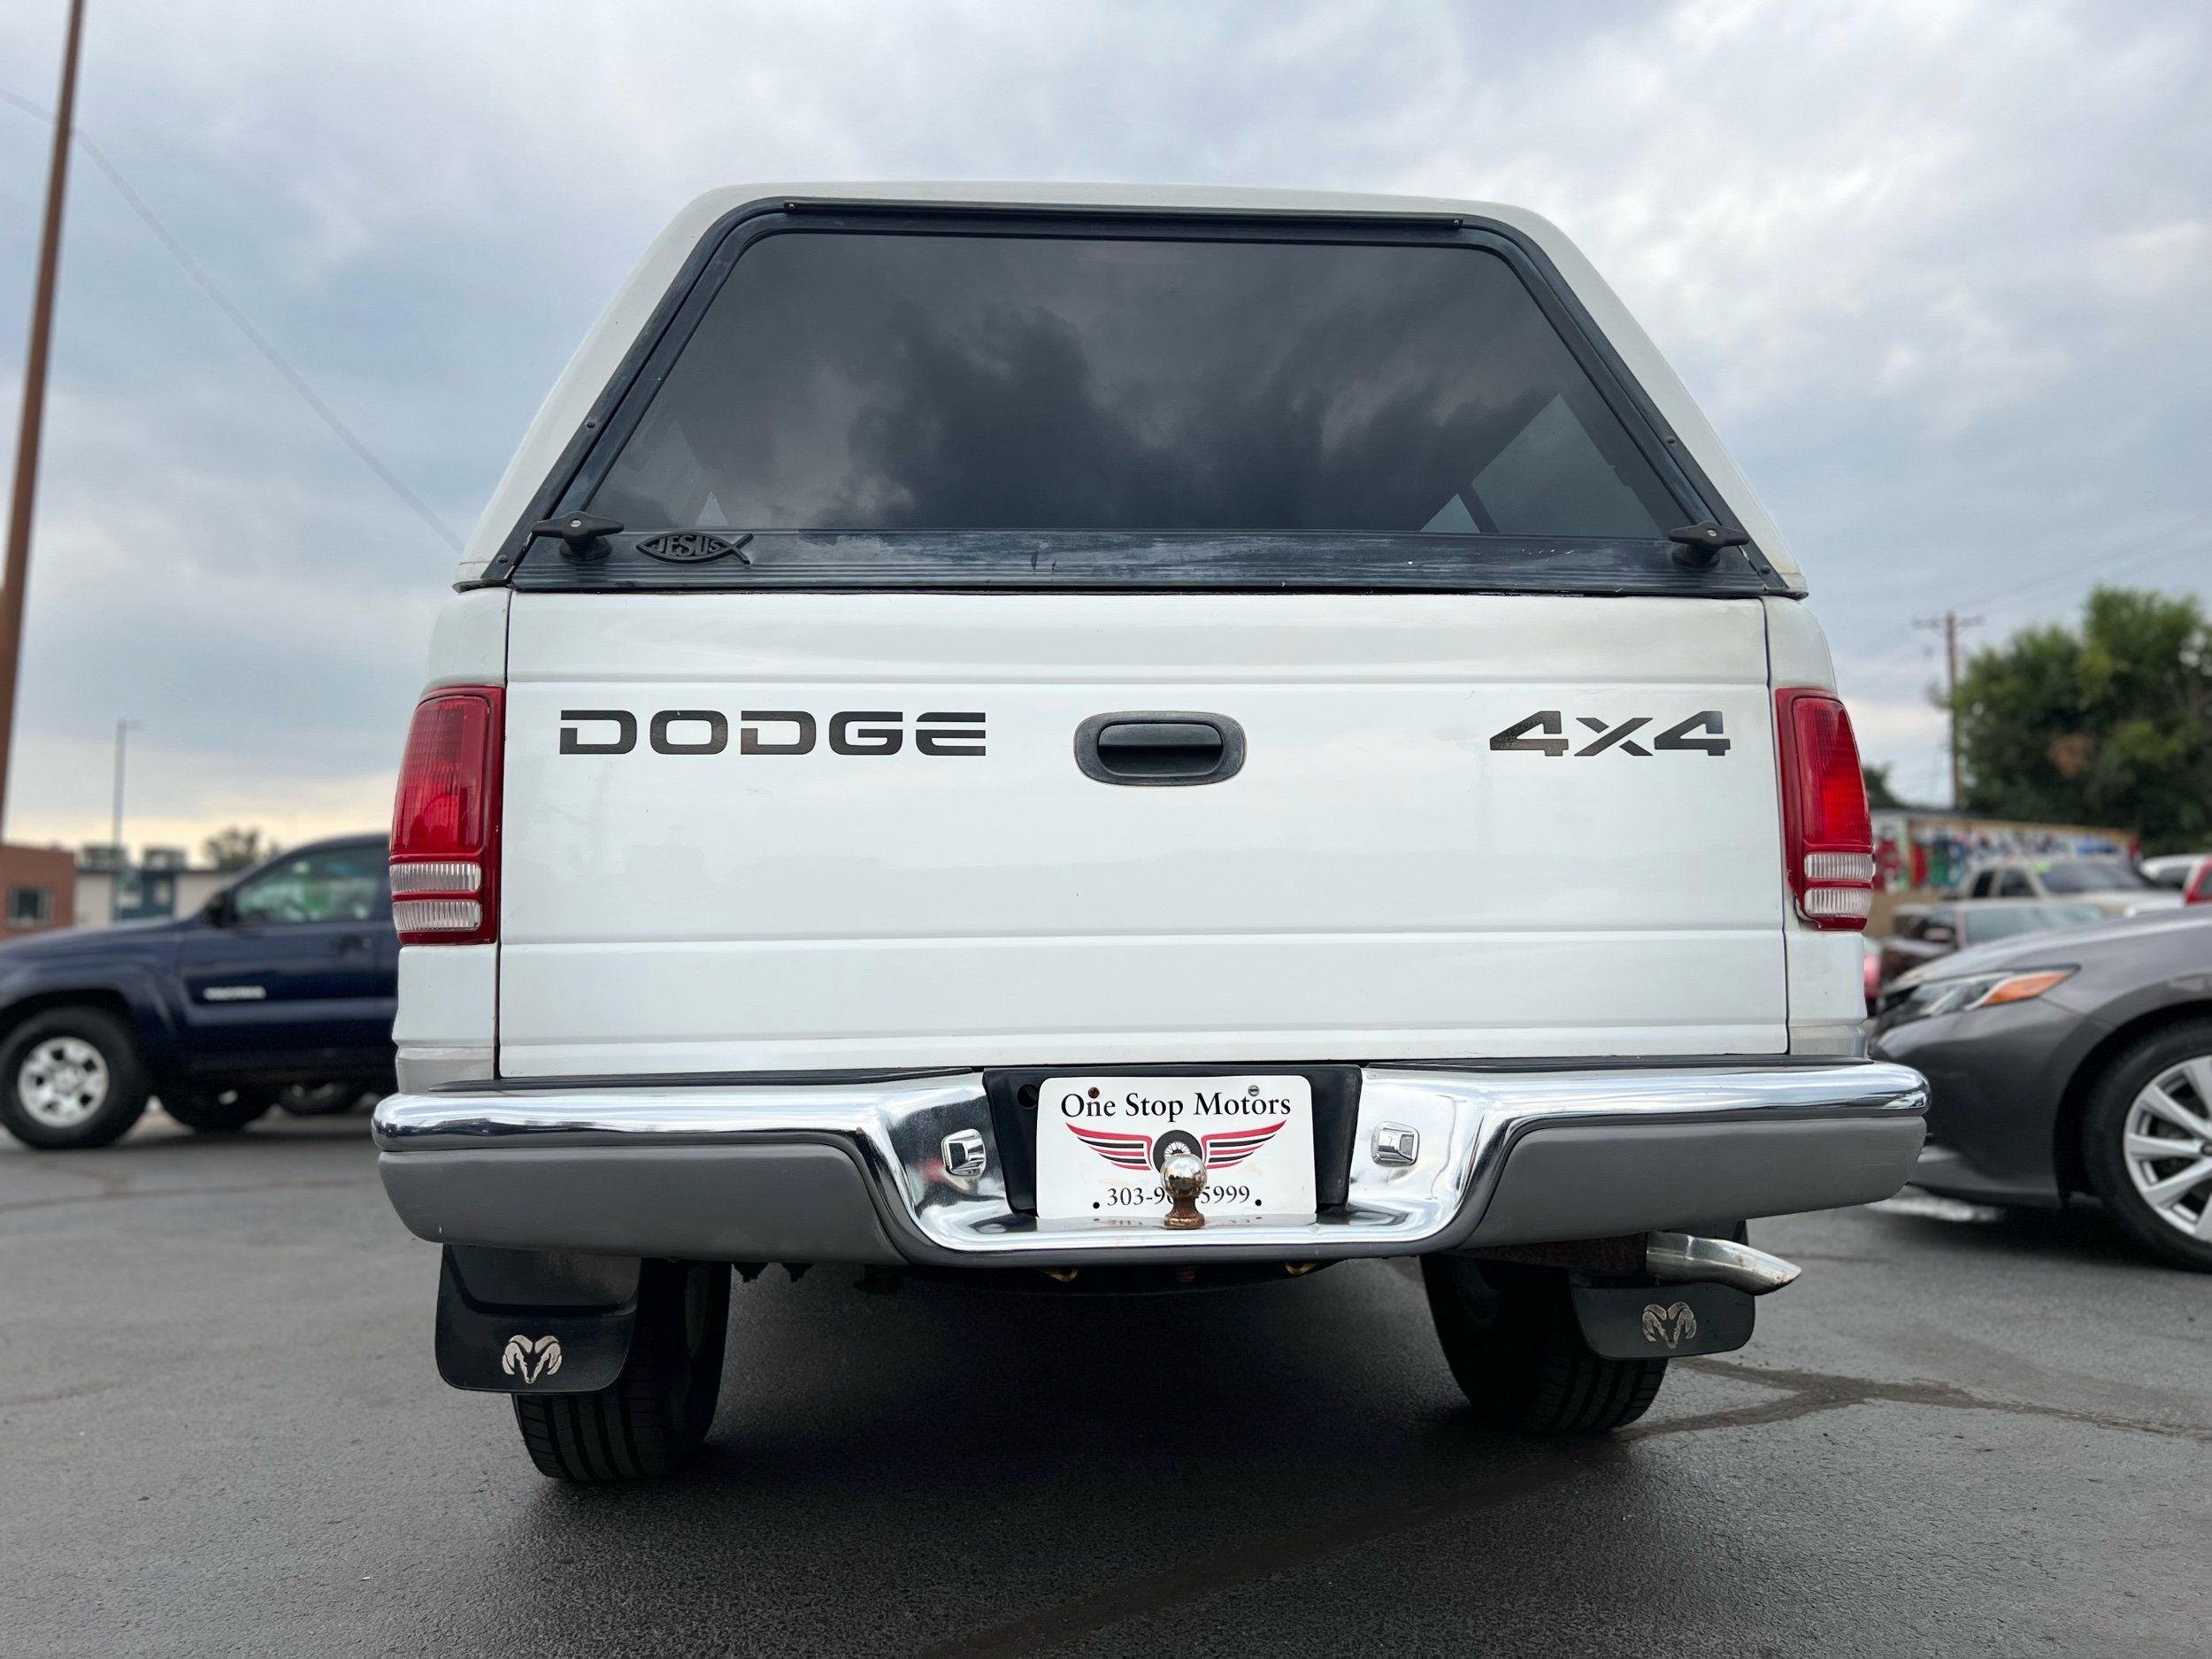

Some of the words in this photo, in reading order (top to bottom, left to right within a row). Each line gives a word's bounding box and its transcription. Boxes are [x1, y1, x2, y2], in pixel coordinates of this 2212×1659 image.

[559, 710, 987, 756] DODGE
[1062, 1093, 1116, 1118] One
[1125, 1092, 1184, 1123] Stop
[1194, 1092, 1291, 1117] Motors
[1107, 1185, 1250, 1206] 303-9-5999
